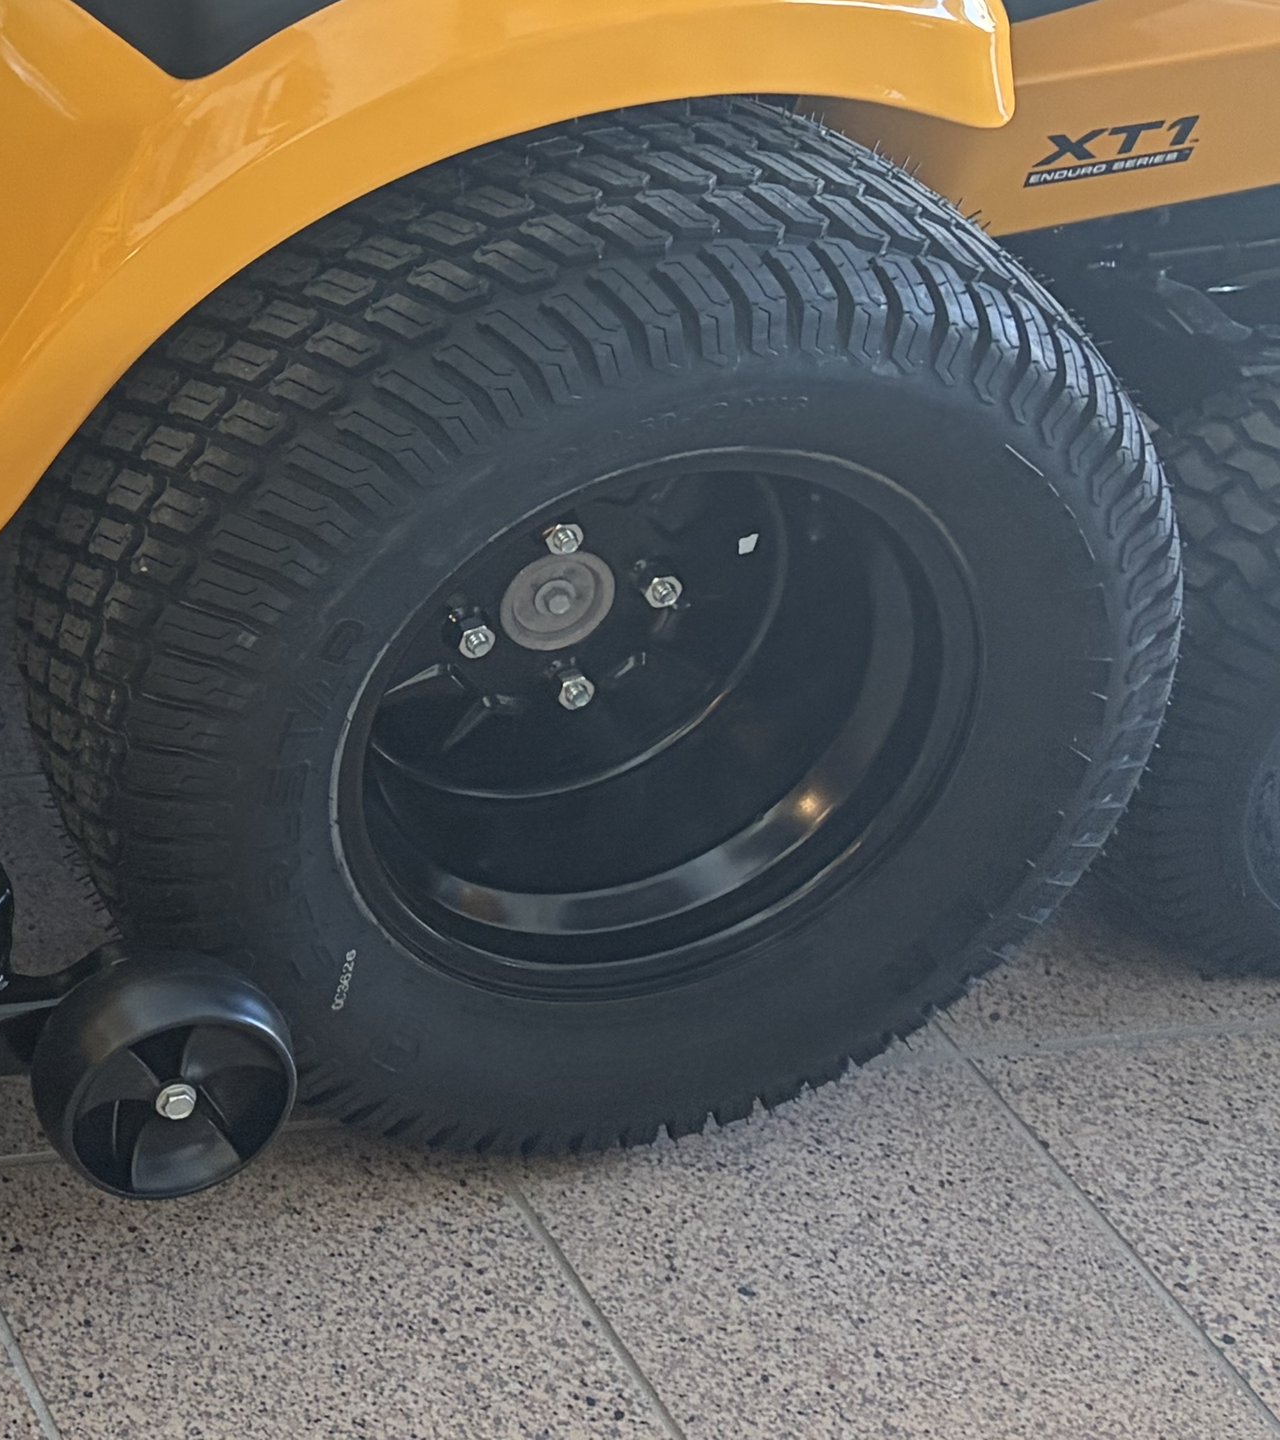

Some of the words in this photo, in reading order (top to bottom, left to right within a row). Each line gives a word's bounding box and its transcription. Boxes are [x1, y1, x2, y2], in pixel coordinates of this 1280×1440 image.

[1032, 115, 1200, 168] XT1
[1028, 163, 1107, 185] ENDURO
[1112, 151, 1178, 171] SERIES
